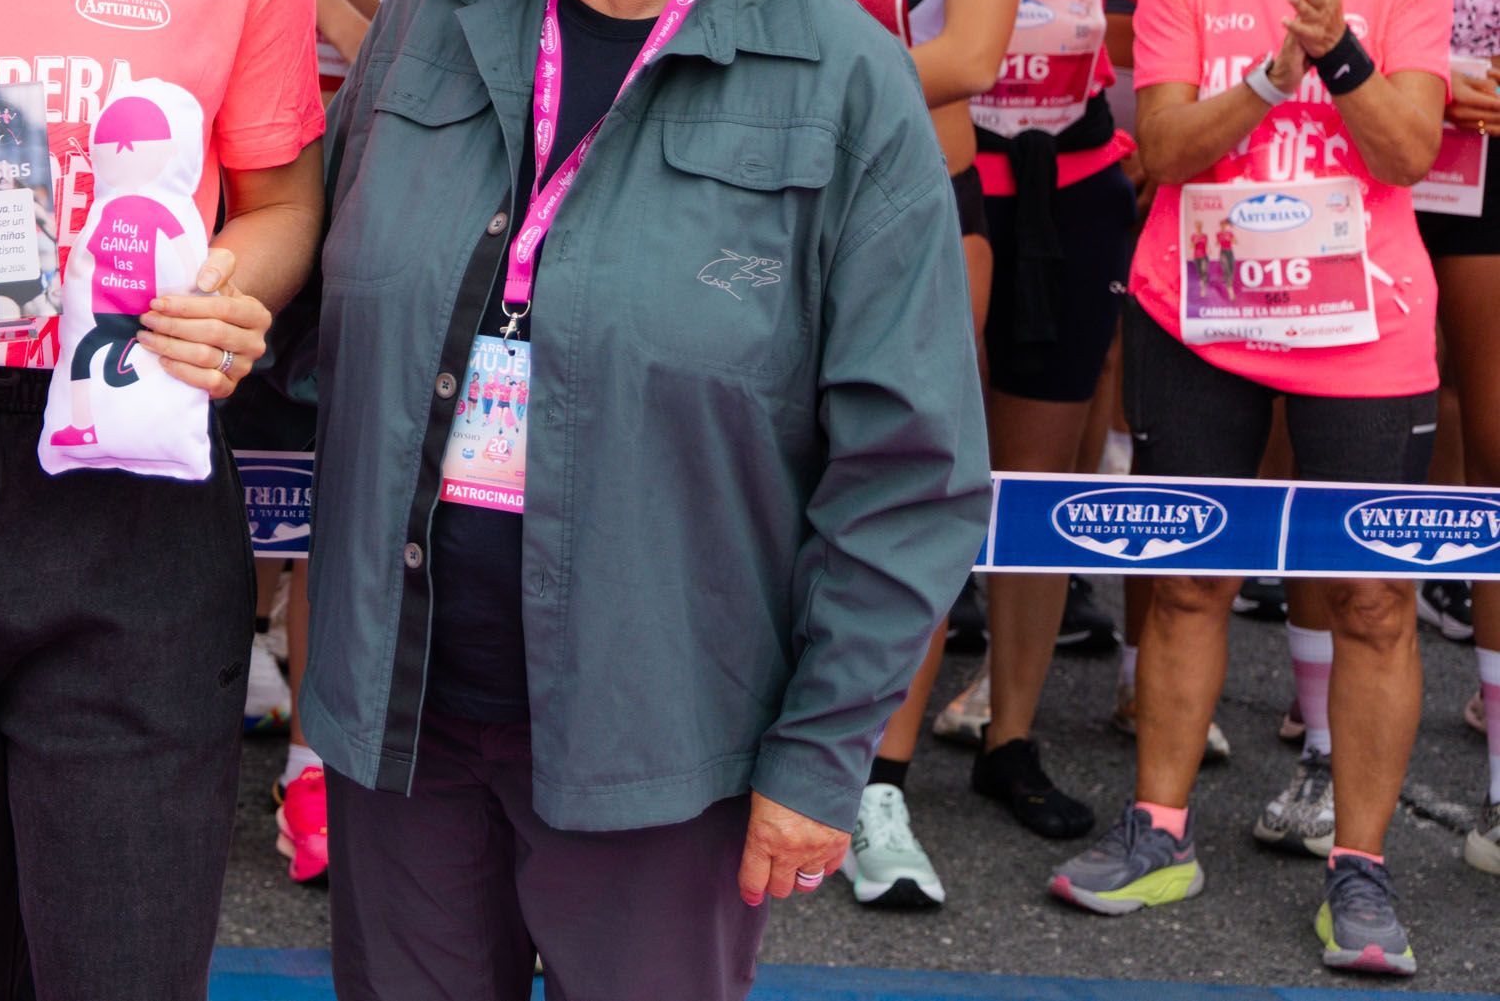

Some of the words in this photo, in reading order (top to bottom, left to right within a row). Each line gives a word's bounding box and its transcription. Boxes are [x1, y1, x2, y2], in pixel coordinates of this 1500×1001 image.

[1204, 13, 1256, 33] YSHO
[13, 204, 24, 212] tu
[1236, 207, 1307, 224] ASTURIANA
[12, 218, 24, 226] un
[112, 219, 139, 238] Hoy
[0, 231, 26, 241] niñas
[101, 236, 149, 253] GANAN
[113, 255, 133, 270] las
[1239, 257, 1312, 288] 016
[101, 272, 147, 290] chicas
[1199, 306, 1241, 318] CARRERA
[1242, 306, 1254, 318] DE
[1256, 305, 1269, 317] LA
[468, 352, 532, 378] MUJE
[488, 439, 509, 453] 20
[446, 484, 525, 507] PATROCINAD
[1066, 503, 1216, 534] ASTURIANA
[1069, 524, 1127, 534] LECHERA
[1131, 526, 1187, 535] CENTRAL
[1361, 529, 1419, 539] LECHERA
[1423, 530, 1481, 540] CENTRAL
